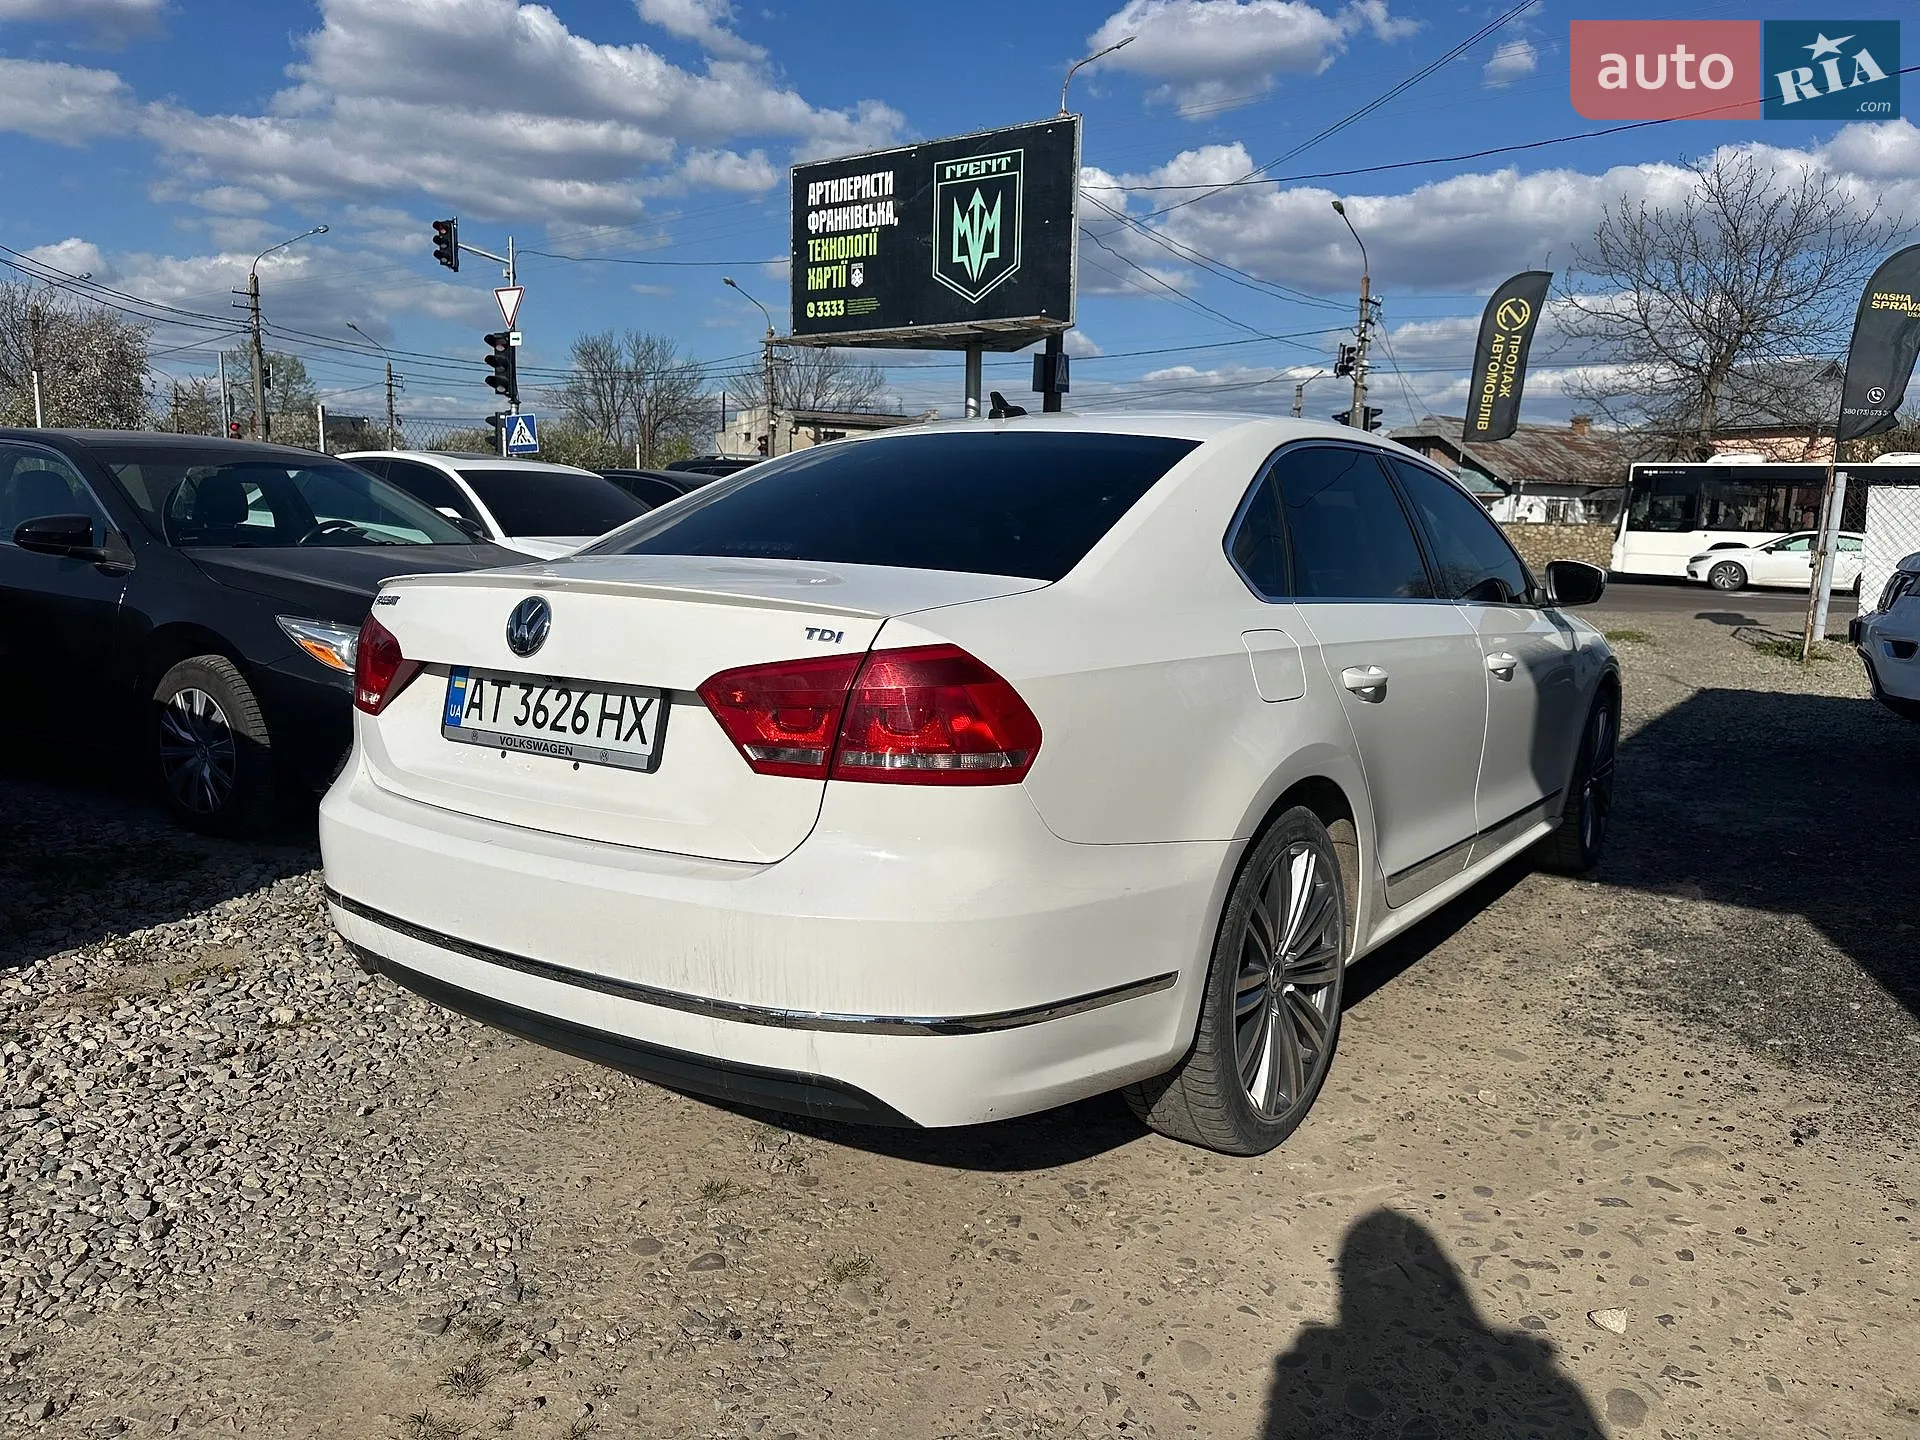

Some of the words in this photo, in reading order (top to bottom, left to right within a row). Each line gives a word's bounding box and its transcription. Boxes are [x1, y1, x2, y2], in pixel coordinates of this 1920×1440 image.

[807, 170, 894, 207] АРТИЛЕРИСТИ
[807, 200, 899, 235] ФРАНКІВСЬКА,
[807, 227, 879, 262] ТЕХНОЛОГІЇ
[807, 259, 849, 291] ХАРТІЇ
[816, 299, 845, 318] 3333
[1871, 300, 1920, 312] SPRAVA
[1872, 292, 1912, 302] NASHA
[1476, 333, 1506, 431] АВТОМОБІЛІВ
[1498, 334, 1522, 398] ПРОДАЖ
[804, 626, 845, 645] TDI
[449, 703, 461, 719] UA
[464, 677, 512, 723] AT
[513, 682, 593, 736] 3626
[596, 692, 655, 746] HX
[499, 735, 574, 757] VOLKSWAGEN
